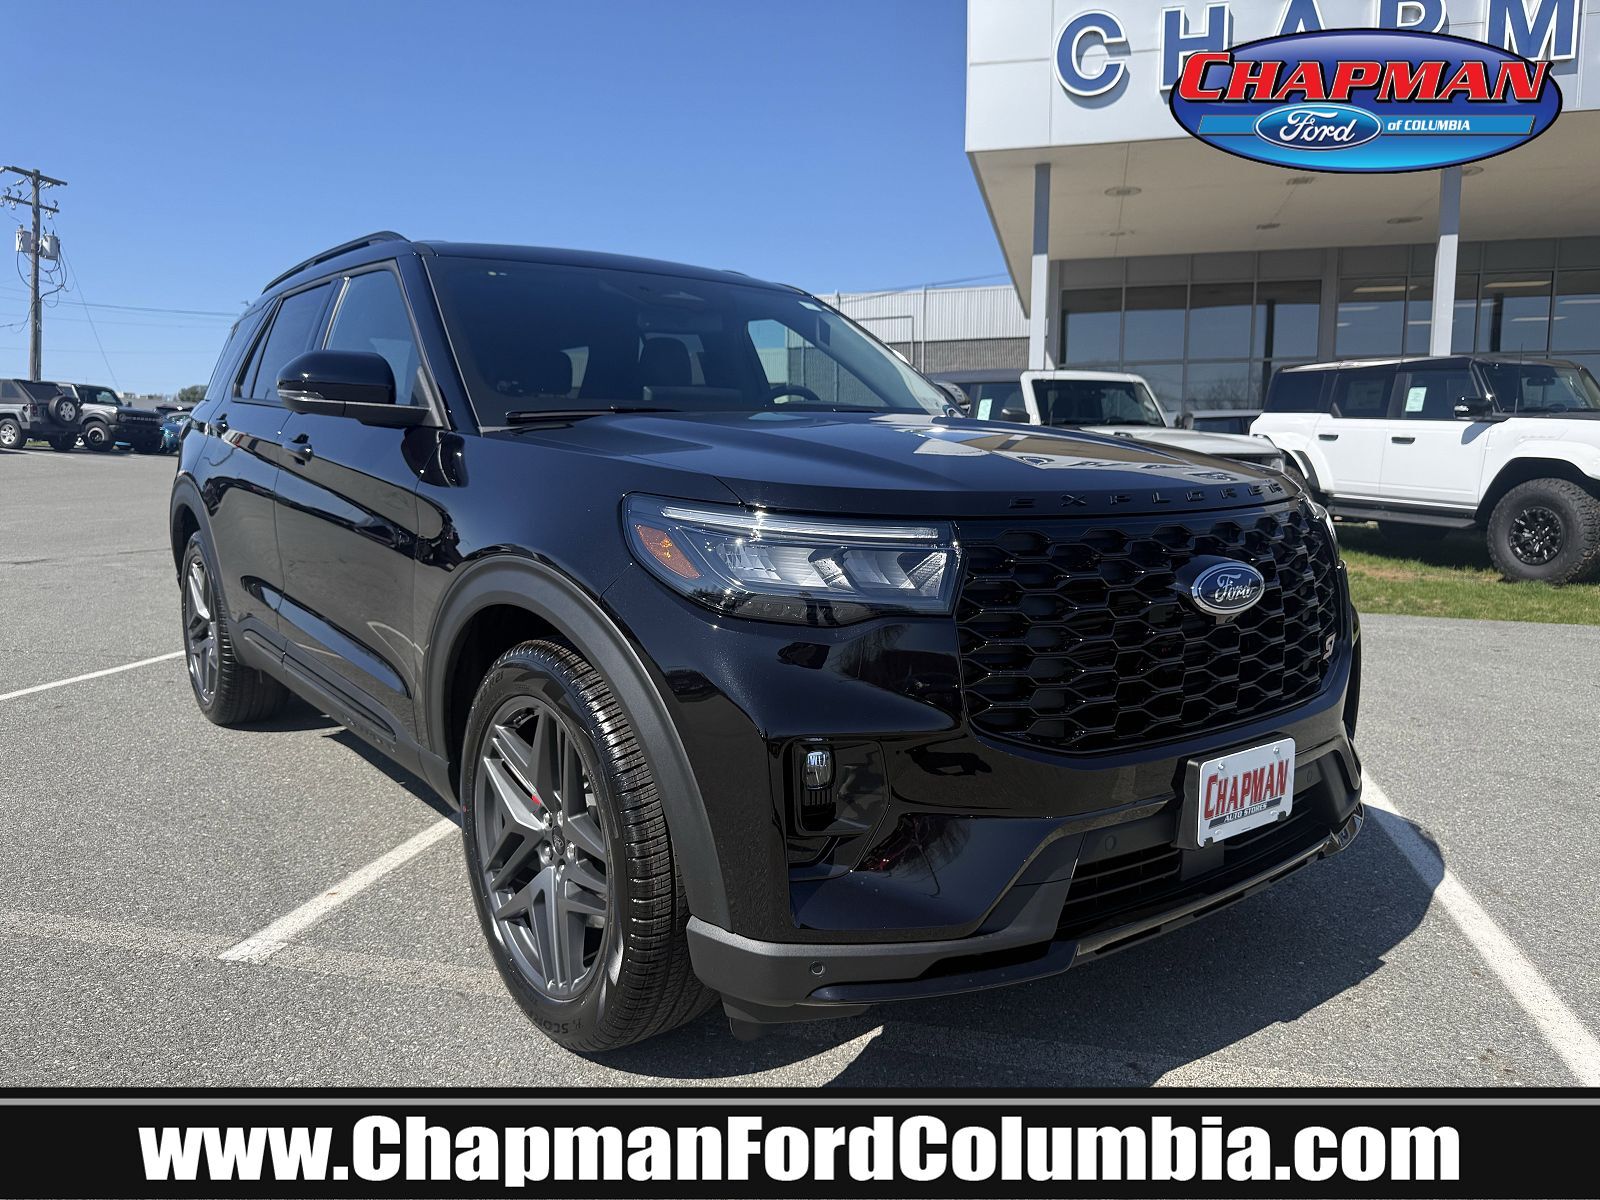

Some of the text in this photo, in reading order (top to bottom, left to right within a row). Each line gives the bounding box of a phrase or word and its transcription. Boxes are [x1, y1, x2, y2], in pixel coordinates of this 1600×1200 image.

[1008, 478, 1285, 510] EXPLORER
[1214, 573, 1258, 602] Ford
[1204, 758, 1290, 821] CHAPMAN
[1223, 810, 1243, 822] AUTO
